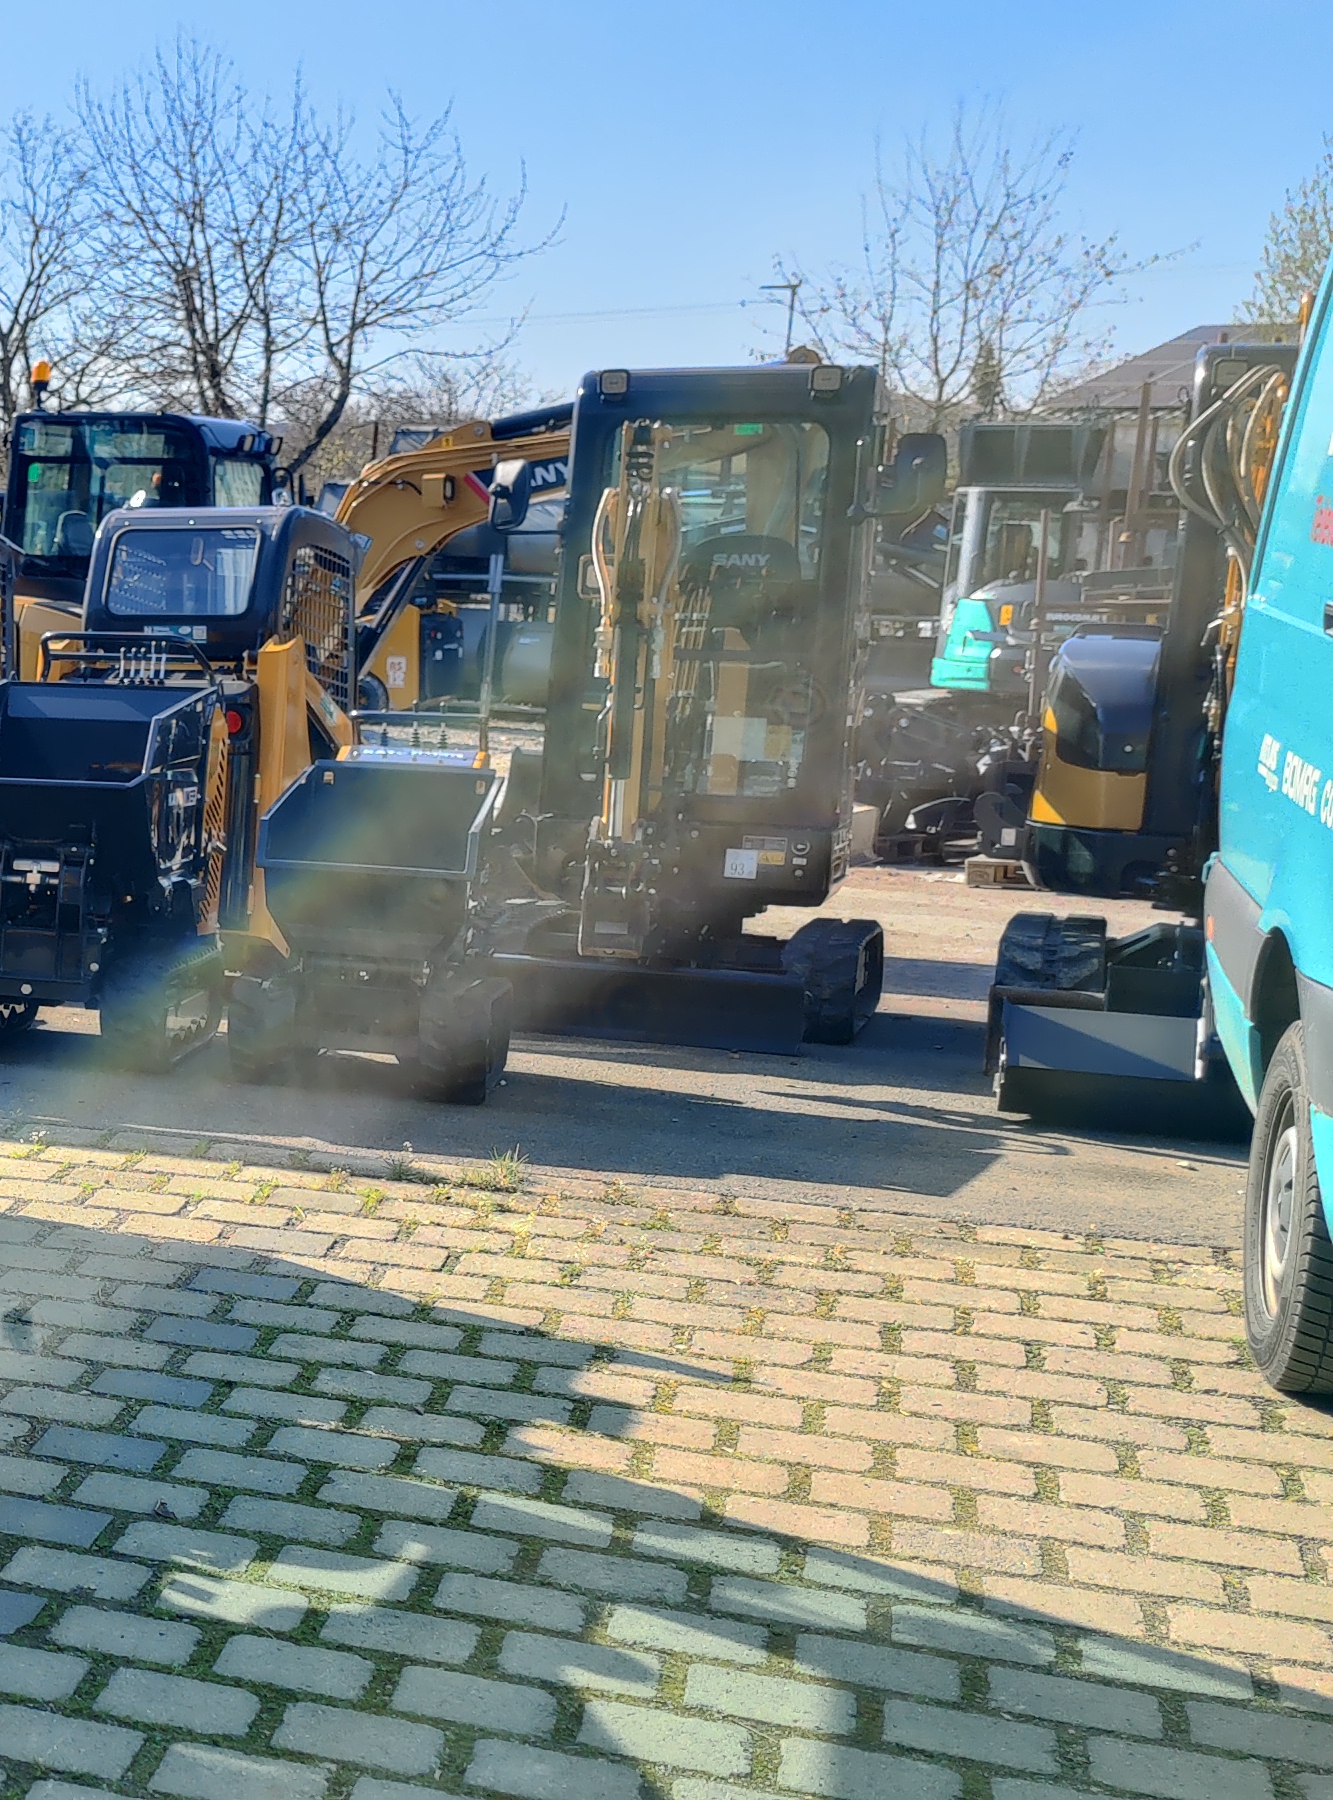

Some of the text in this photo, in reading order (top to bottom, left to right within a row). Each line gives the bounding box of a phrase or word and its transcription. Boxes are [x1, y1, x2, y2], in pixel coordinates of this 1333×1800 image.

[530, 461, 570, 487] NY
[712, 553, 771, 569] SANY
[730, 862, 745, 876] 93
